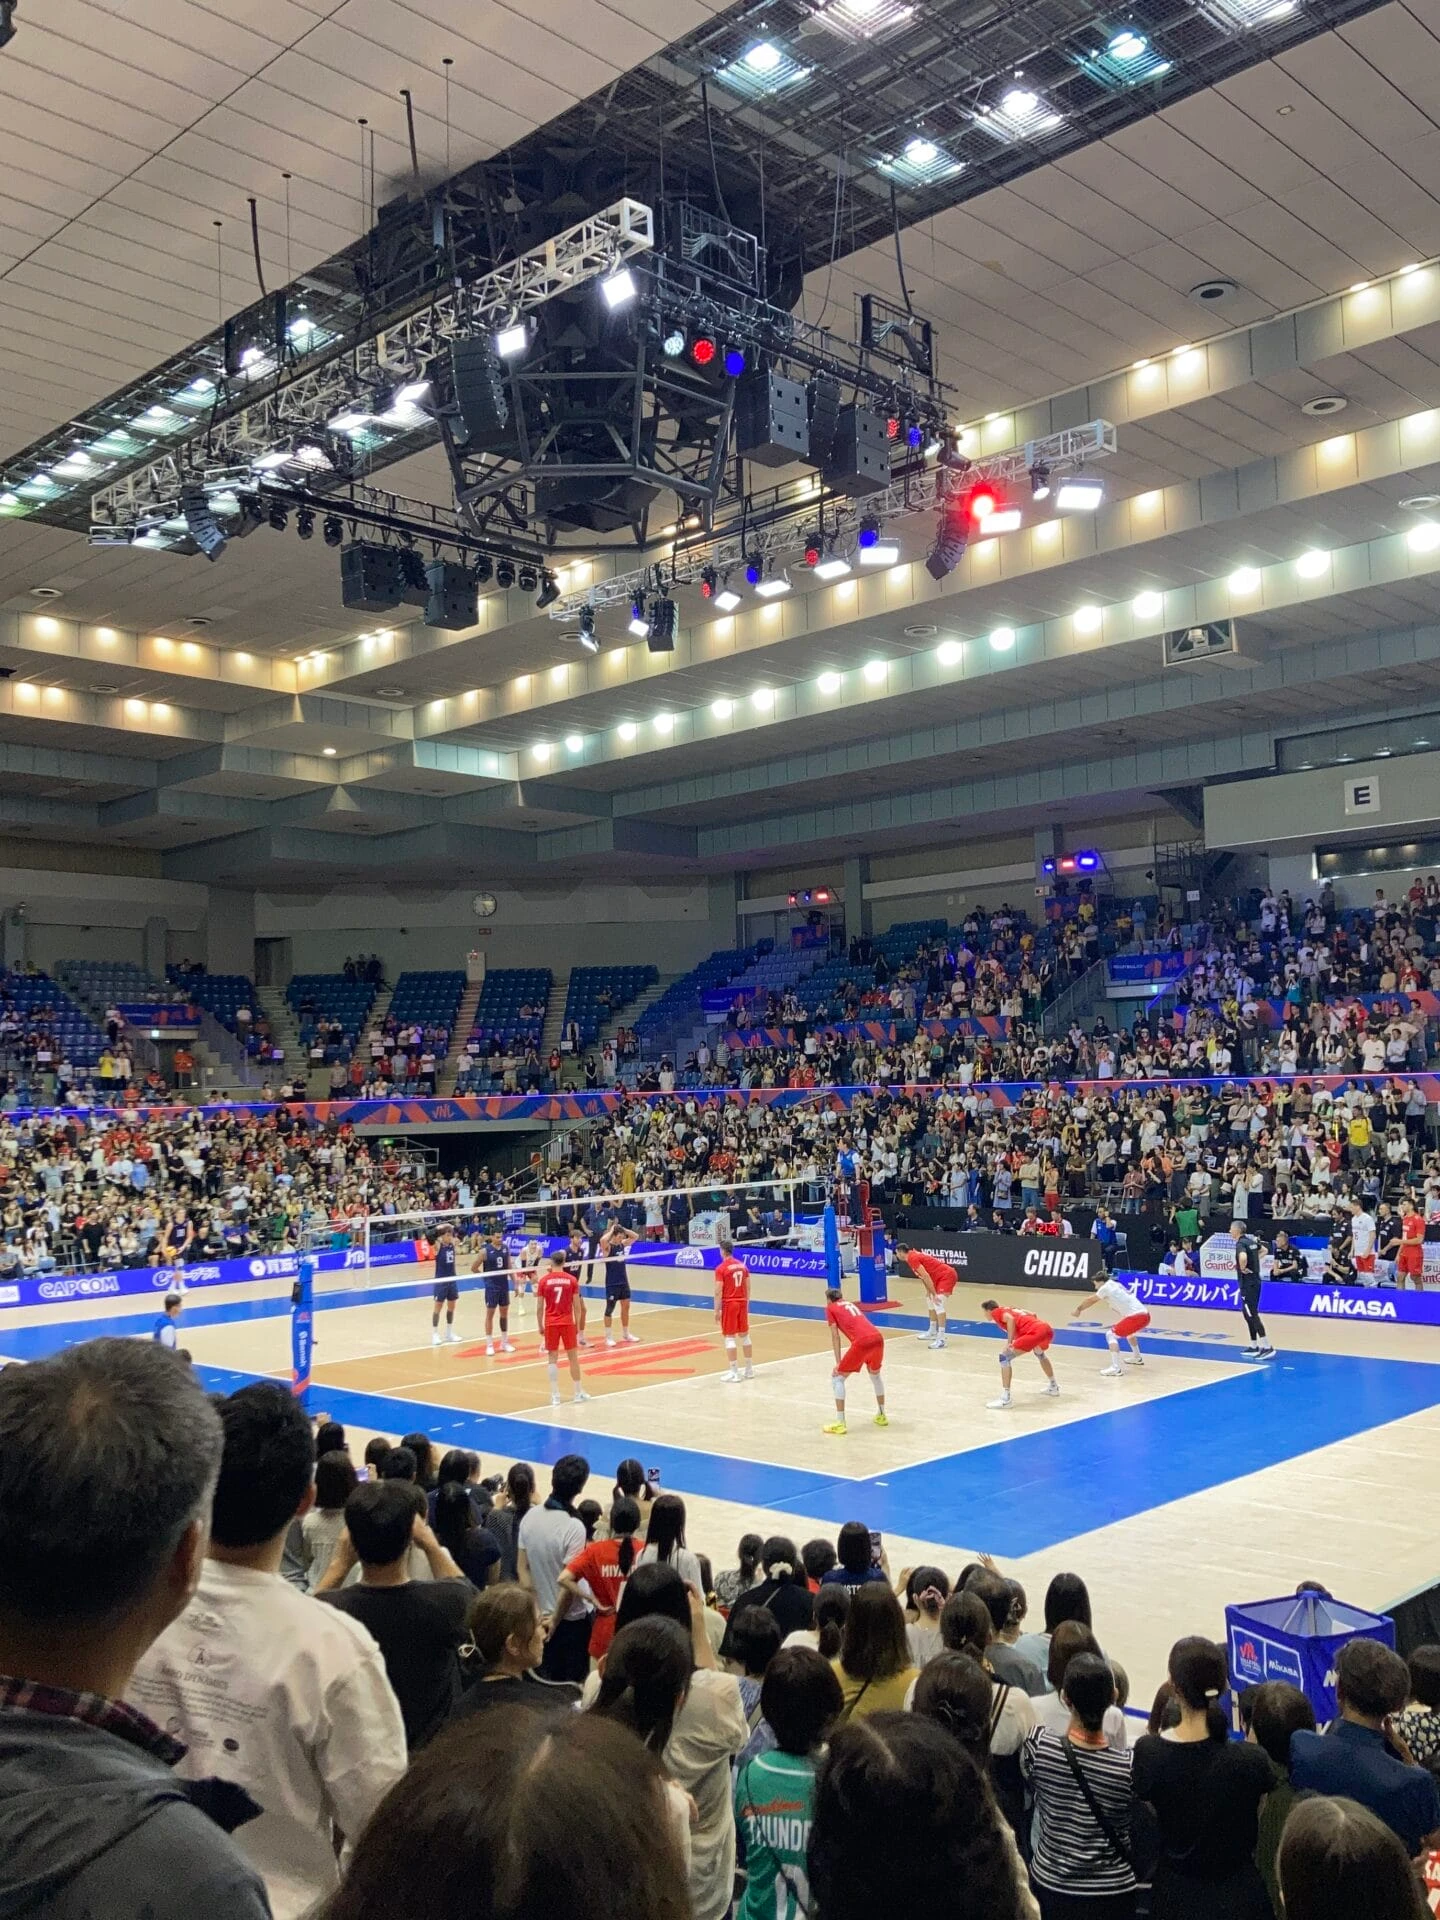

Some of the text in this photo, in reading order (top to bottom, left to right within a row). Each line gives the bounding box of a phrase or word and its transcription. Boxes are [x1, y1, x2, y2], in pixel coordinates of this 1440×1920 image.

[1354, 785, 1370, 805] E
[742, 1254, 780, 1268] TOKIO
[921, 1248, 968, 1259] VOLLEYBALL
[497, 1256, 504, 1268] 9
[1024, 1249, 1089, 1279] CHIBA
[39, 1276, 119, 1298] CAPCOM
[733, 1271, 743, 1287] 17
[554, 1286, 563, 1303] 7
